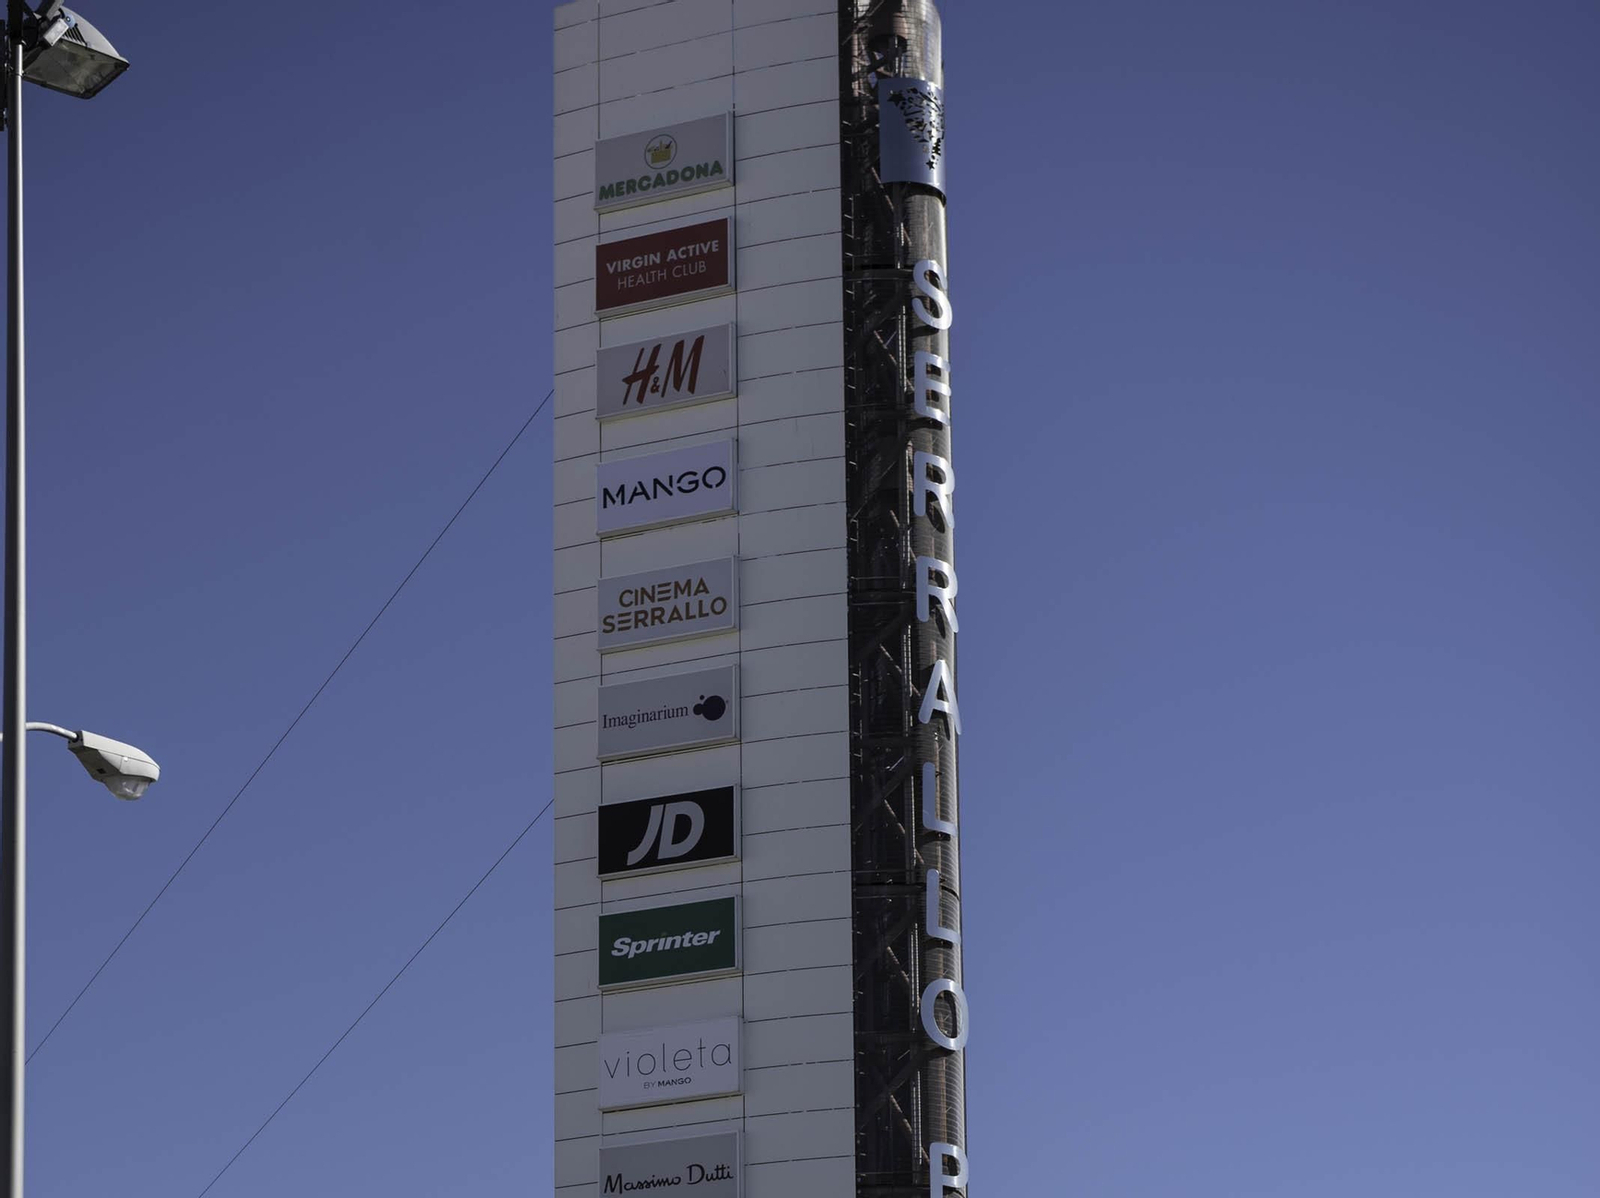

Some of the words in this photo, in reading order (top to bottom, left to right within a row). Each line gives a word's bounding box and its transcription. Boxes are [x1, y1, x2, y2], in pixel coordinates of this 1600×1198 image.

[599, 159, 724, 201] MERCADONA
[606, 251, 661, 274] VIRGIN
[666, 240, 720, 262] ACTIVE
[617, 269, 667, 290] HEALTH
[672, 260, 707, 278] CLUB
[622, 334, 706, 406] H&M
[601, 465, 727, 510] MANGO
[618, 577, 710, 608] CINEMA
[601, 596, 728, 634] SERRALLO
[912, 259, 970, 1051] SERRALLO
[602, 703, 689, 730] Imaginarium
[626, 800, 705, 866] JD
[611, 927, 721, 959] Sprinter
[604, 1037, 732, 1079] violeta
[643, 1080, 656, 1090] BY
[657, 1076, 692, 1088] MANGO
[603, 1173, 682, 1195] Massimo
[686, 1163, 735, 1185] Dutti
